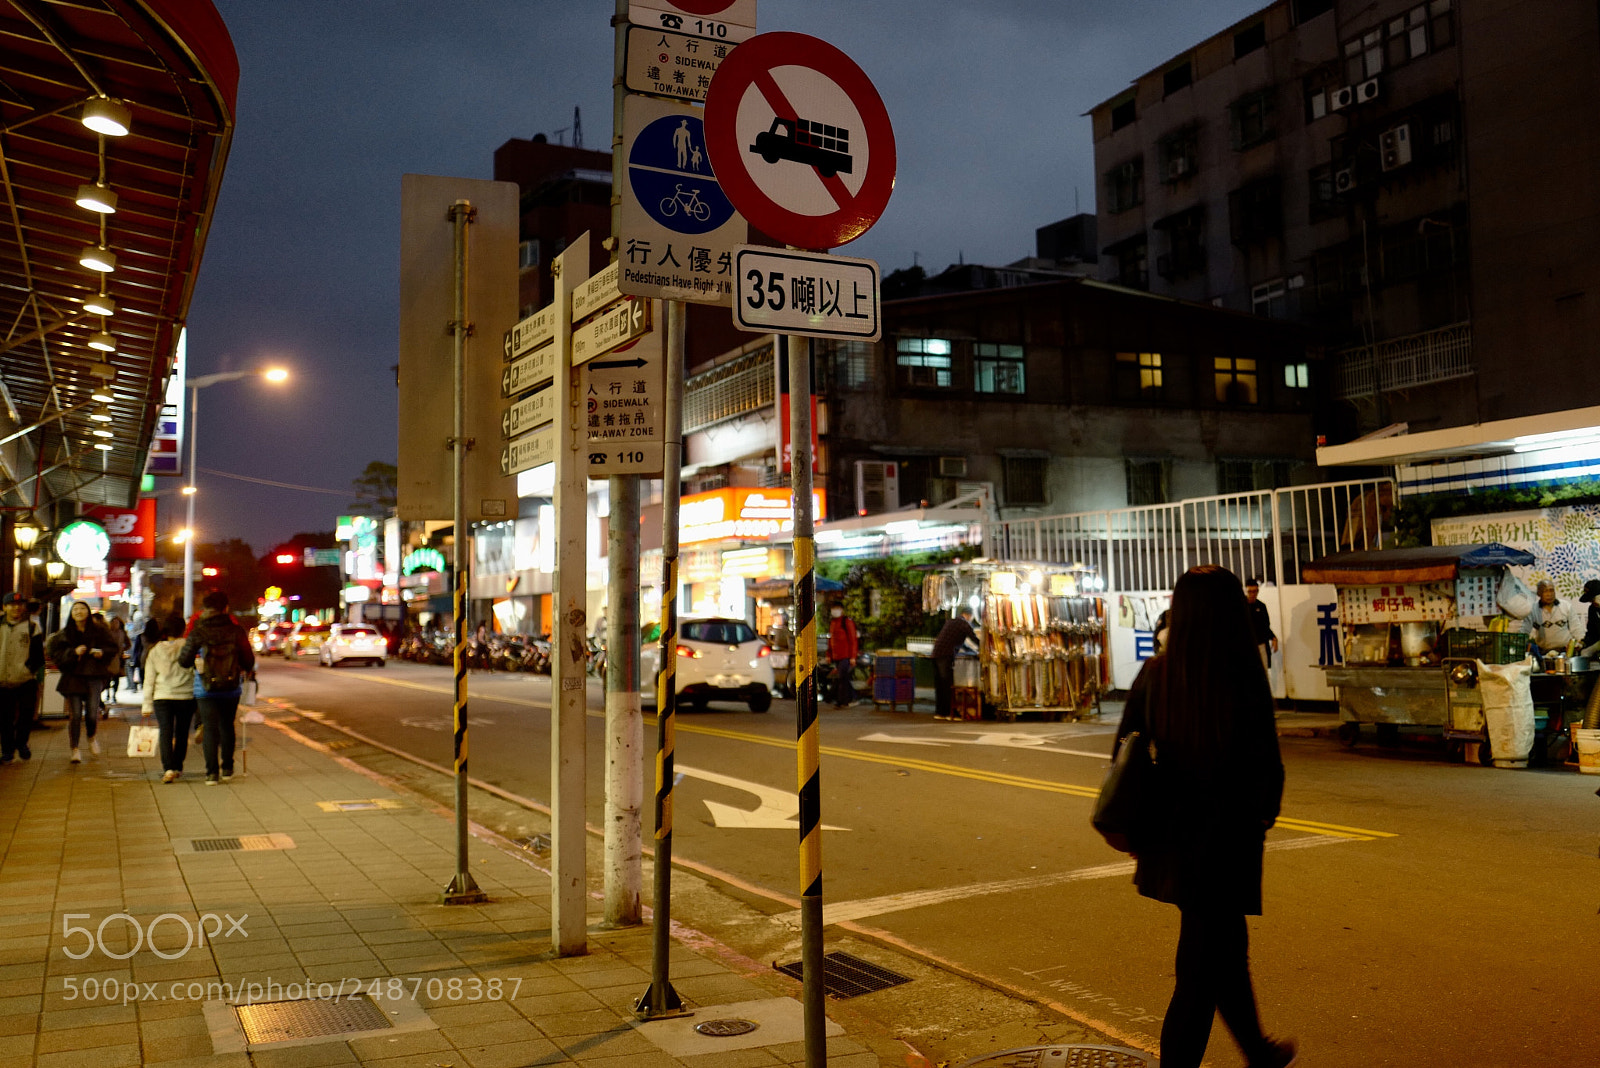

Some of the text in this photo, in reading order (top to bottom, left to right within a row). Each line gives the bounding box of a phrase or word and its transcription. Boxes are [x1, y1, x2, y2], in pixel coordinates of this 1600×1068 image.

[695, 20, 727, 38] 110
[657, 35, 727, 58] 人行道
[675, 56, 720, 71] SIDEWAL
[654, 82, 700, 97] TOW-AWAY
[626, 239, 732, 276] 行人優先
[625, 268, 670, 286] Pedestrians
[672, 274, 692, 289] Have
[693, 277, 714, 294] Right
[587, 380, 646, 395] 人行道
[603, 397, 649, 408] SIDEWALK
[587, 411, 645, 427] 違者拖吊
[630, 427, 654, 437] ZONE
[617, 451, 644, 463] 110
[1471, 520, 1539, 544] 公館分店
